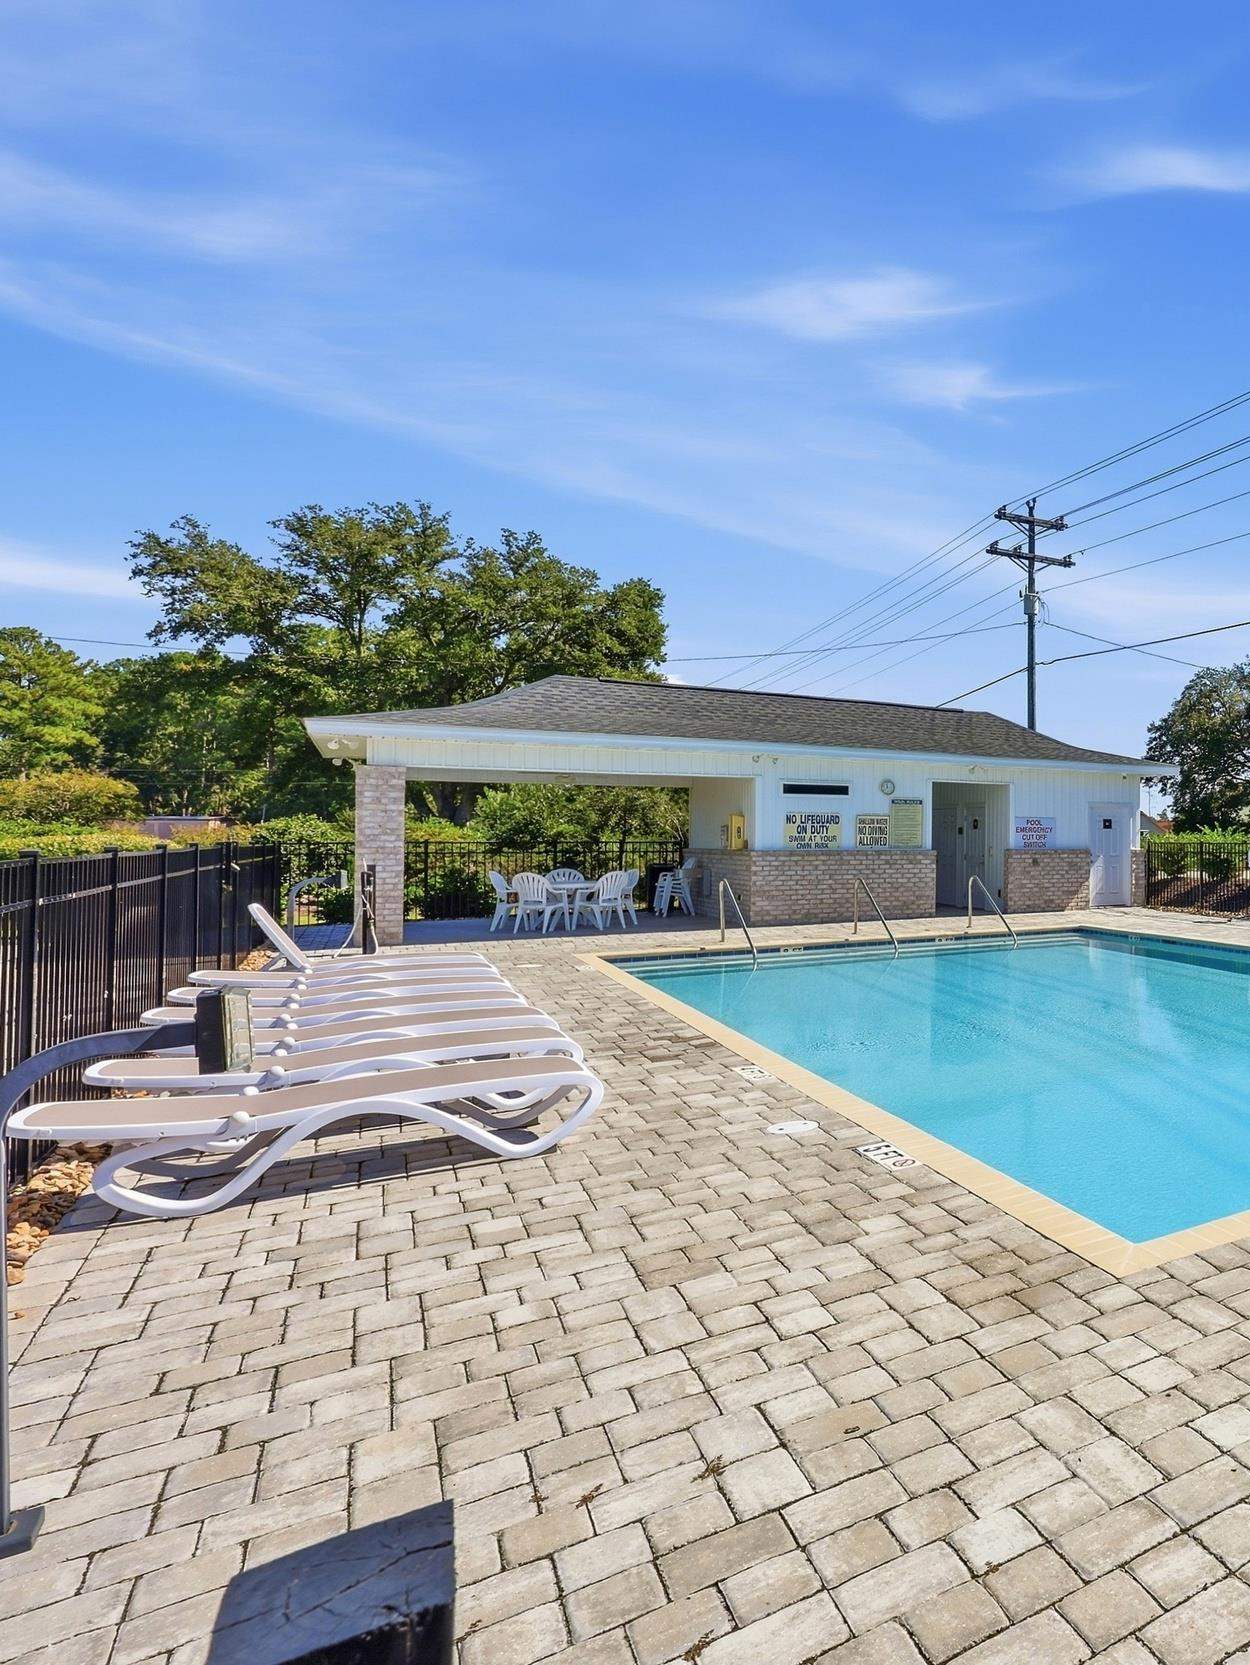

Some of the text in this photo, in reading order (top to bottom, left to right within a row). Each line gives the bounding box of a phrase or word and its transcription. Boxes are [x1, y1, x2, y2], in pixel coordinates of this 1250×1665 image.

[786, 814, 840, 824] NO LIFEGUARD
[796, 824, 829, 834] ON DUTY
[858, 826, 888, 835] NO DIVING
[858, 836, 888, 846] ALLOWED
[873, 1150, 905, 1161] FT
